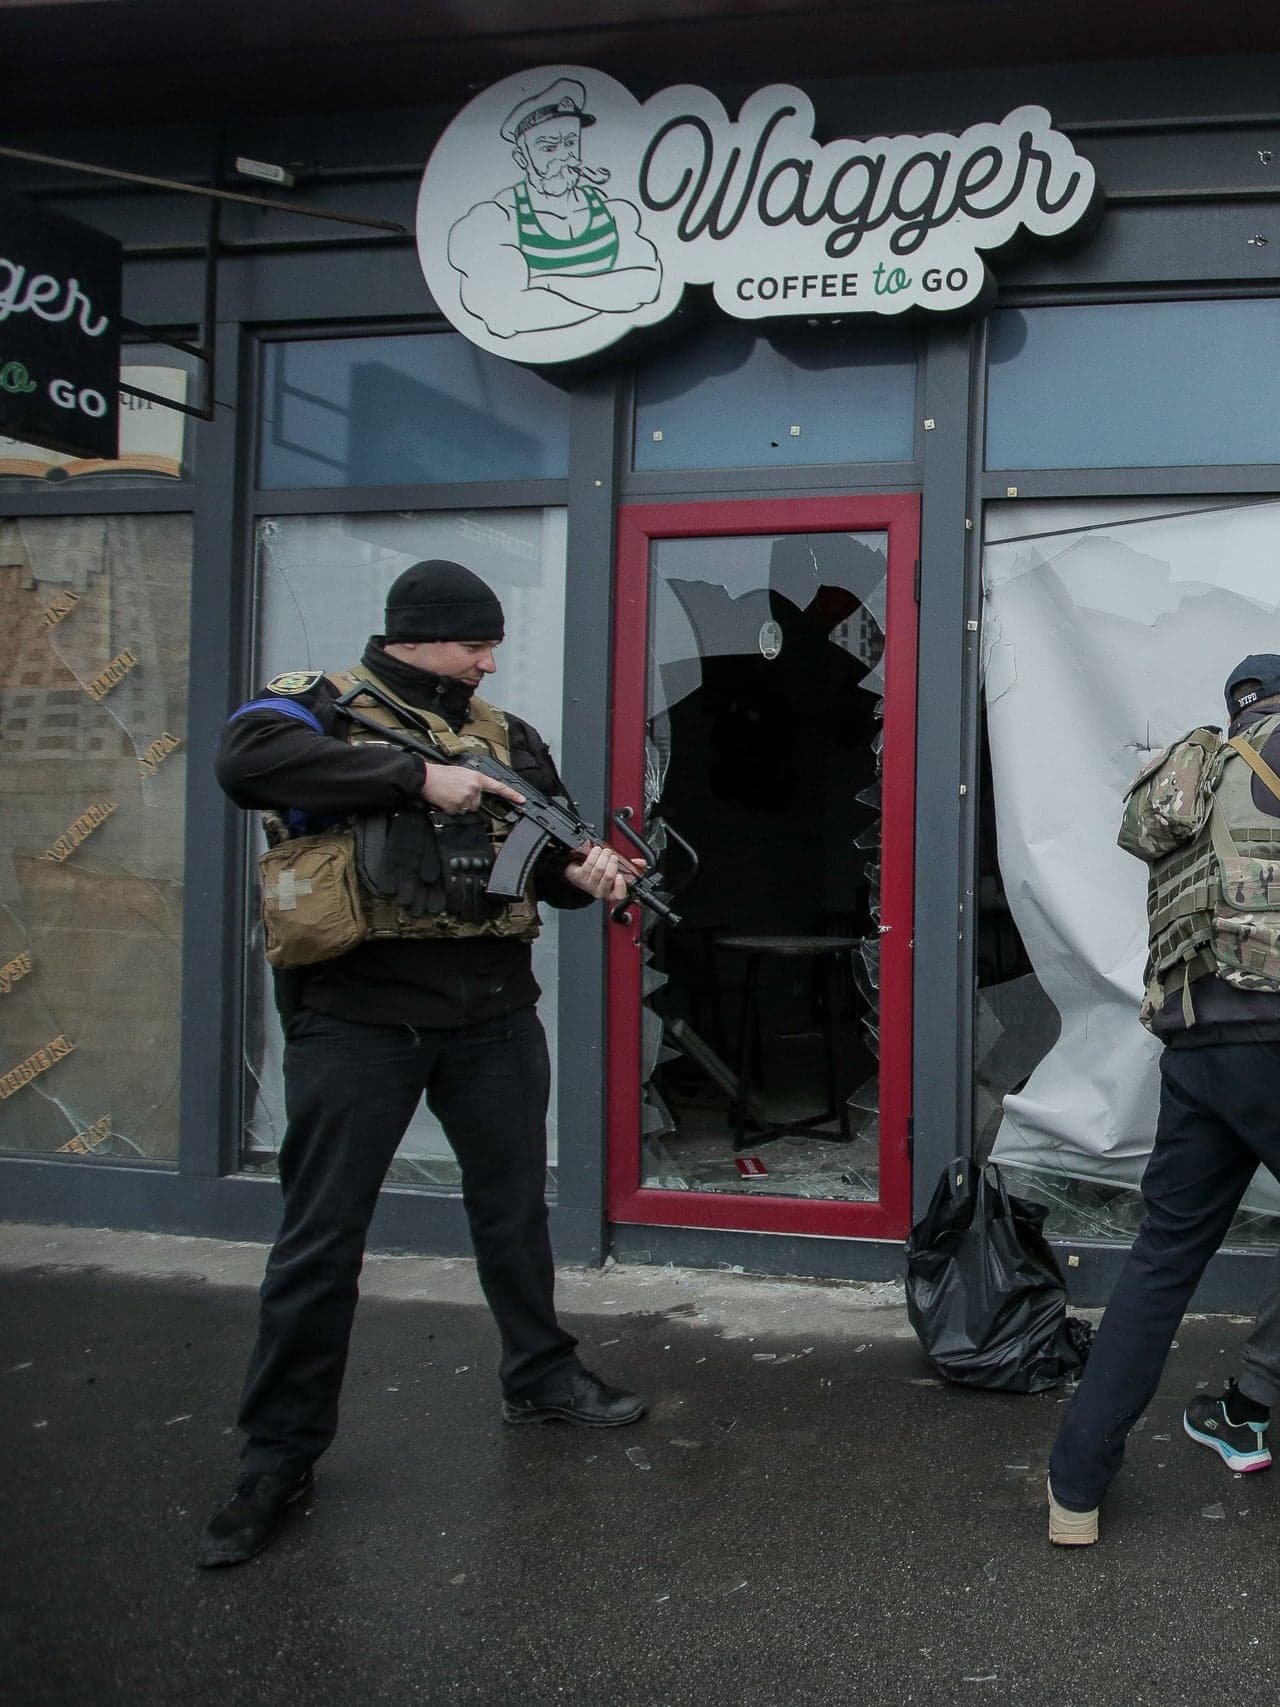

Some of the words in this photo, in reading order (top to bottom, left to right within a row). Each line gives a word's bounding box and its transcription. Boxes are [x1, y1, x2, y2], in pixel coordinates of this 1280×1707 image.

[638, 105, 1081, 259] Wagger
[735, 272, 859, 302] COFFEE
[872, 261, 913, 296] to
[921, 267, 969, 293] GO
[49, 378, 108, 418] GO
[1237, 692, 1258, 708] NYPD
